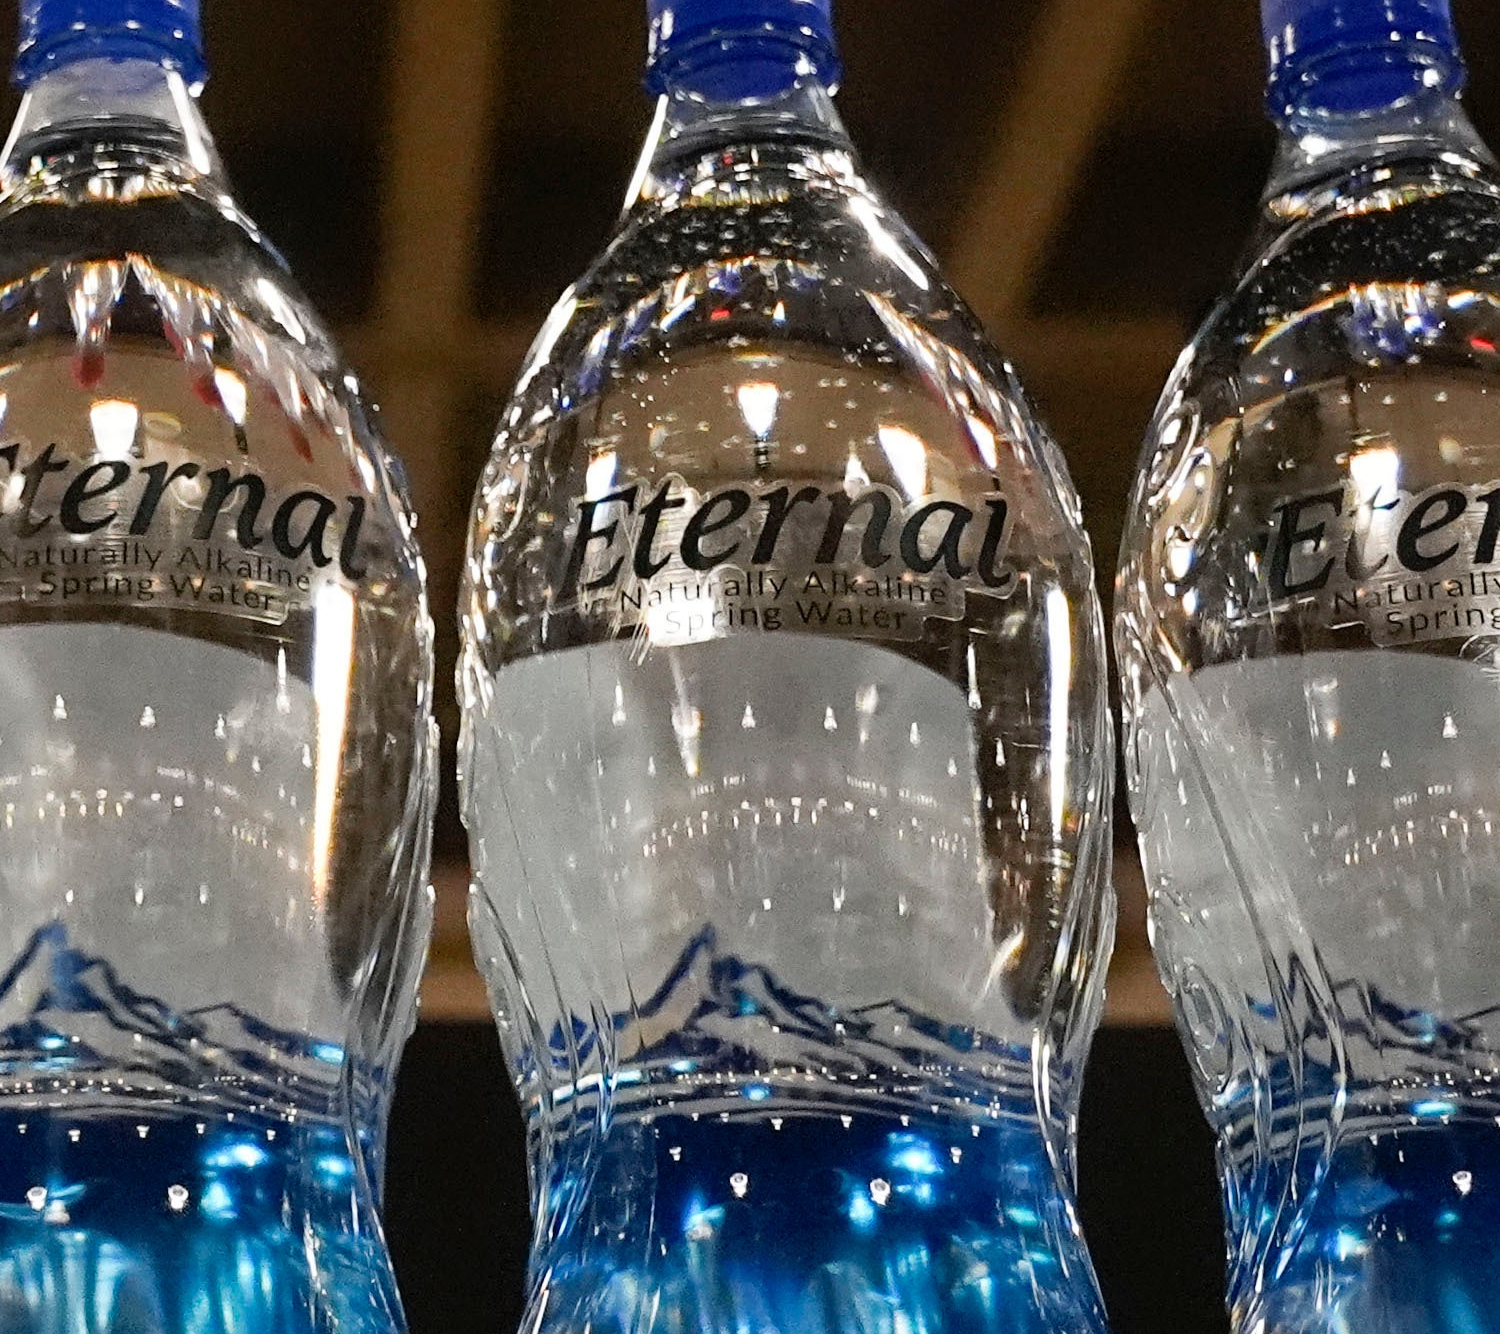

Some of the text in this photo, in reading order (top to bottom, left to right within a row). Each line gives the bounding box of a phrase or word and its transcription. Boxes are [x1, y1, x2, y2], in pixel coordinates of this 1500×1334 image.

[555, 482, 1012, 601] Eternal
[39, 570, 276, 611] Spring Water
[177, 545, 310, 595] Alkaline
[621, 569, 947, 613] Naturally Alkaline
[665, 600, 909, 636] Spring Water
